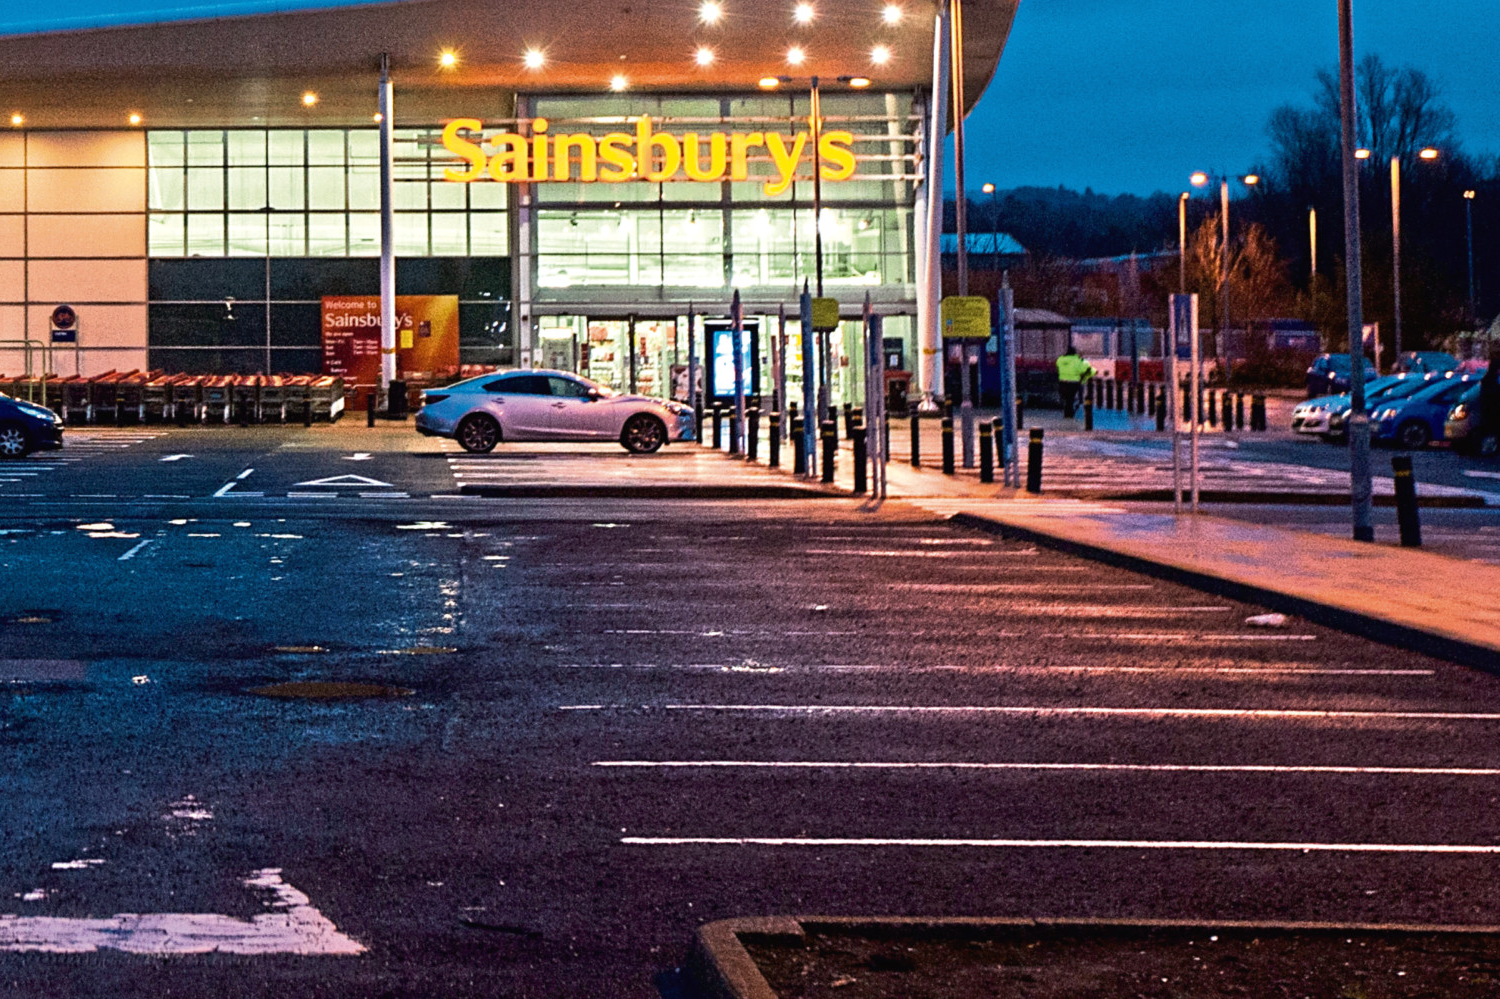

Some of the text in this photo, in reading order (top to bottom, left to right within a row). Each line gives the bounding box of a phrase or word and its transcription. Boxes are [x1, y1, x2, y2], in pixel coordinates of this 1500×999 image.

[442, 114, 856, 196] Sainsbury's
[325, 301, 377, 309] Welcome to
[325, 313, 413, 329] Sainsby's
